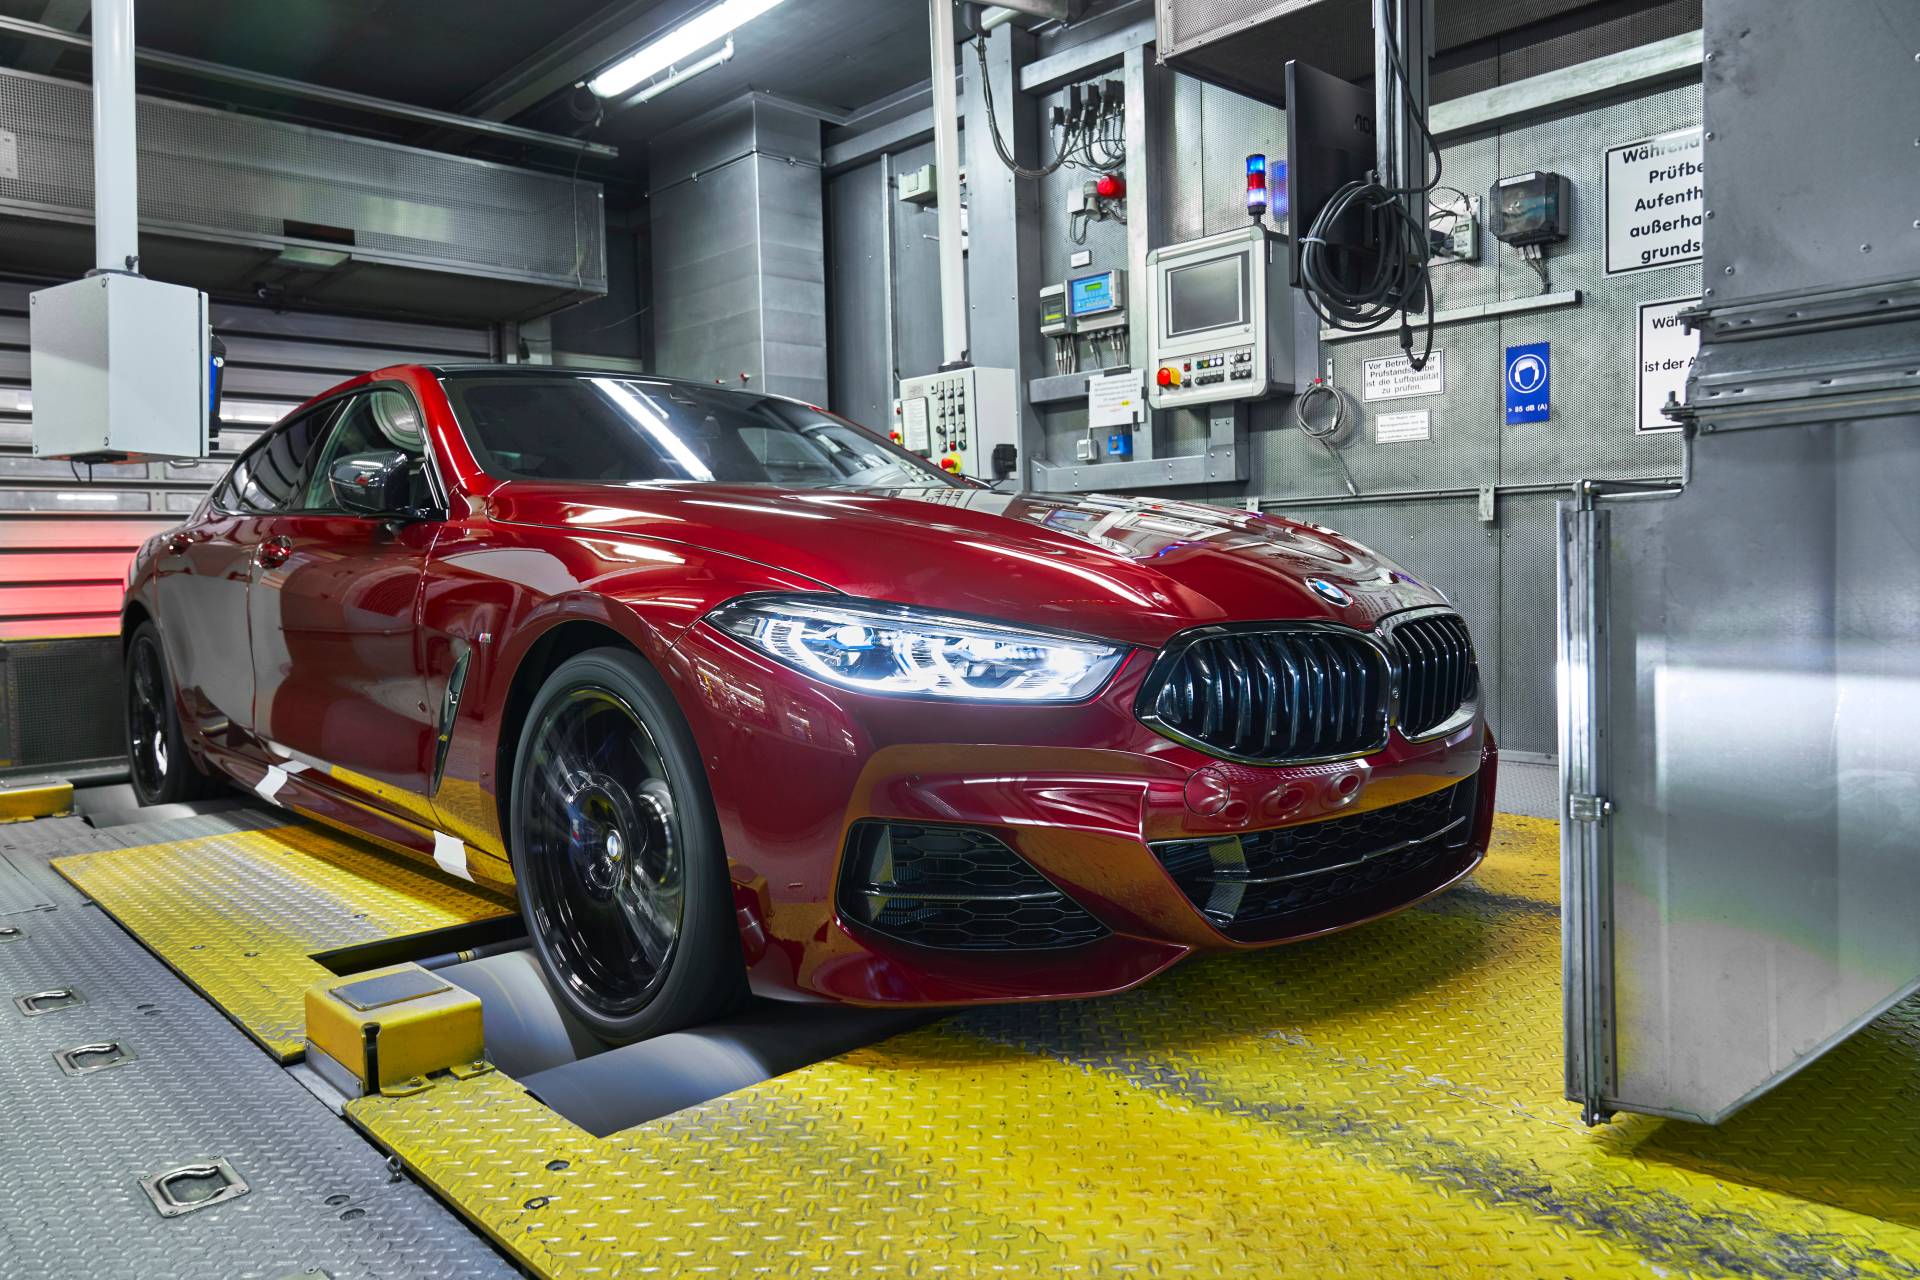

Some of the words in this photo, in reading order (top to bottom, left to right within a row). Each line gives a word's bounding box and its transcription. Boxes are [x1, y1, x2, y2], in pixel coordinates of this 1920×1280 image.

[1641, 238, 1703, 265] grunds
[1368, 362, 1381, 370] Vor
[1385, 358, 1412, 368] Betret
[1644, 360, 1659, 372] ist
[1662, 358, 1684, 370] der
[1366, 379, 1375, 388] ist
[1379, 378, 1391, 386] die
[1381, 386, 1391, 395] zu
[1537, 403, 1547, 411] (A)
